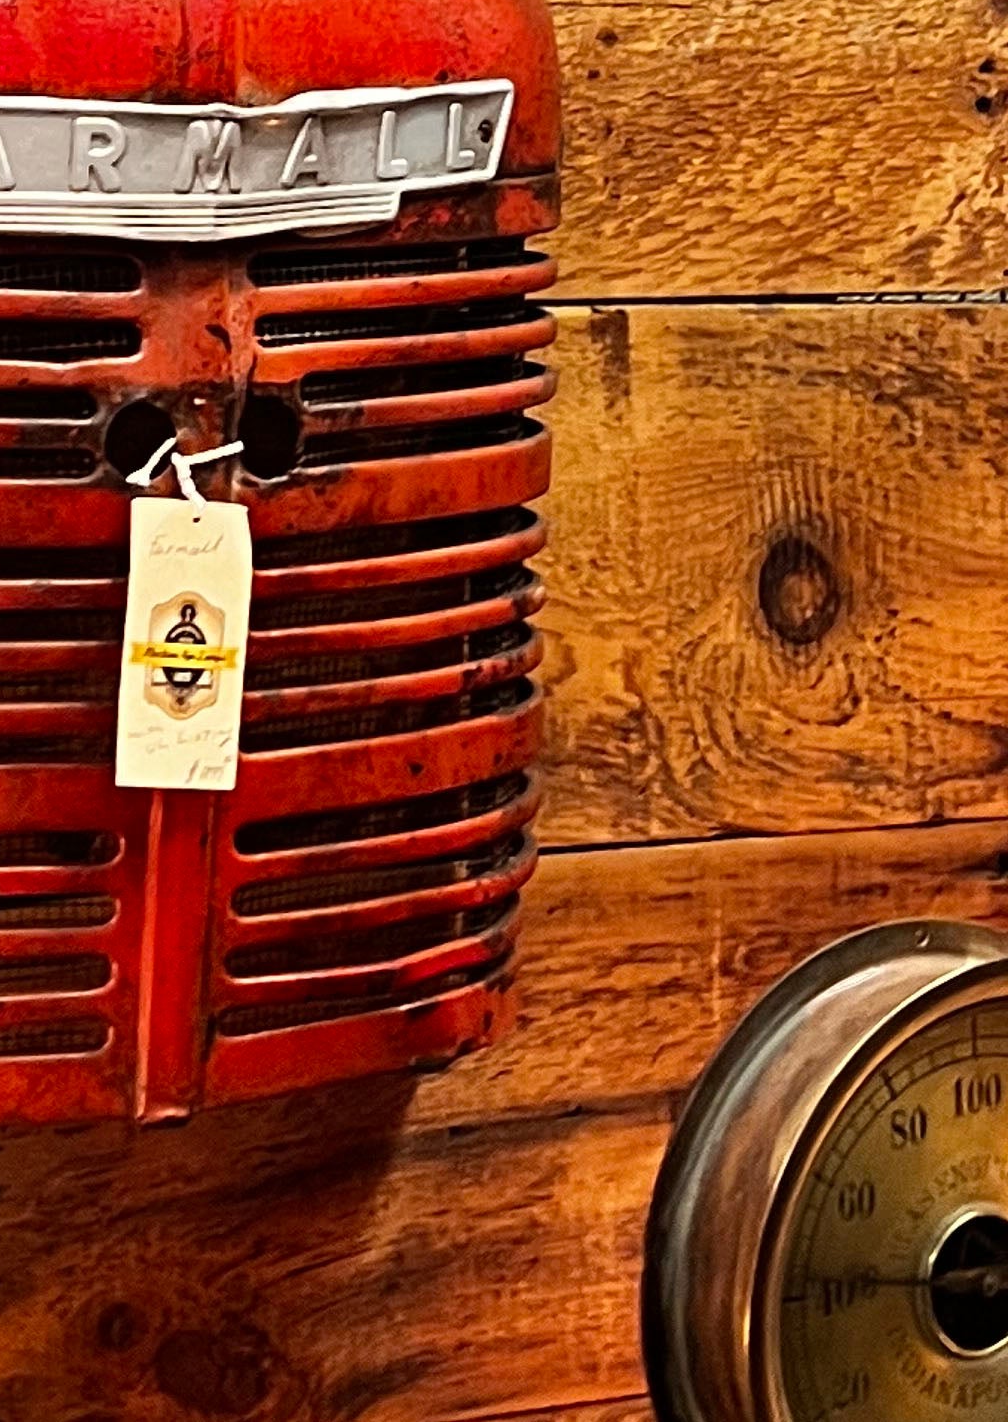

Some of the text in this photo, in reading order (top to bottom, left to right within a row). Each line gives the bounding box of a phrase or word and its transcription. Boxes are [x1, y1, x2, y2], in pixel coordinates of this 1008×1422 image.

[955, 1074, 1002, 1116] 100
[891, 1106, 927, 1149] 80
[838, 1181, 875, 1221] 60
